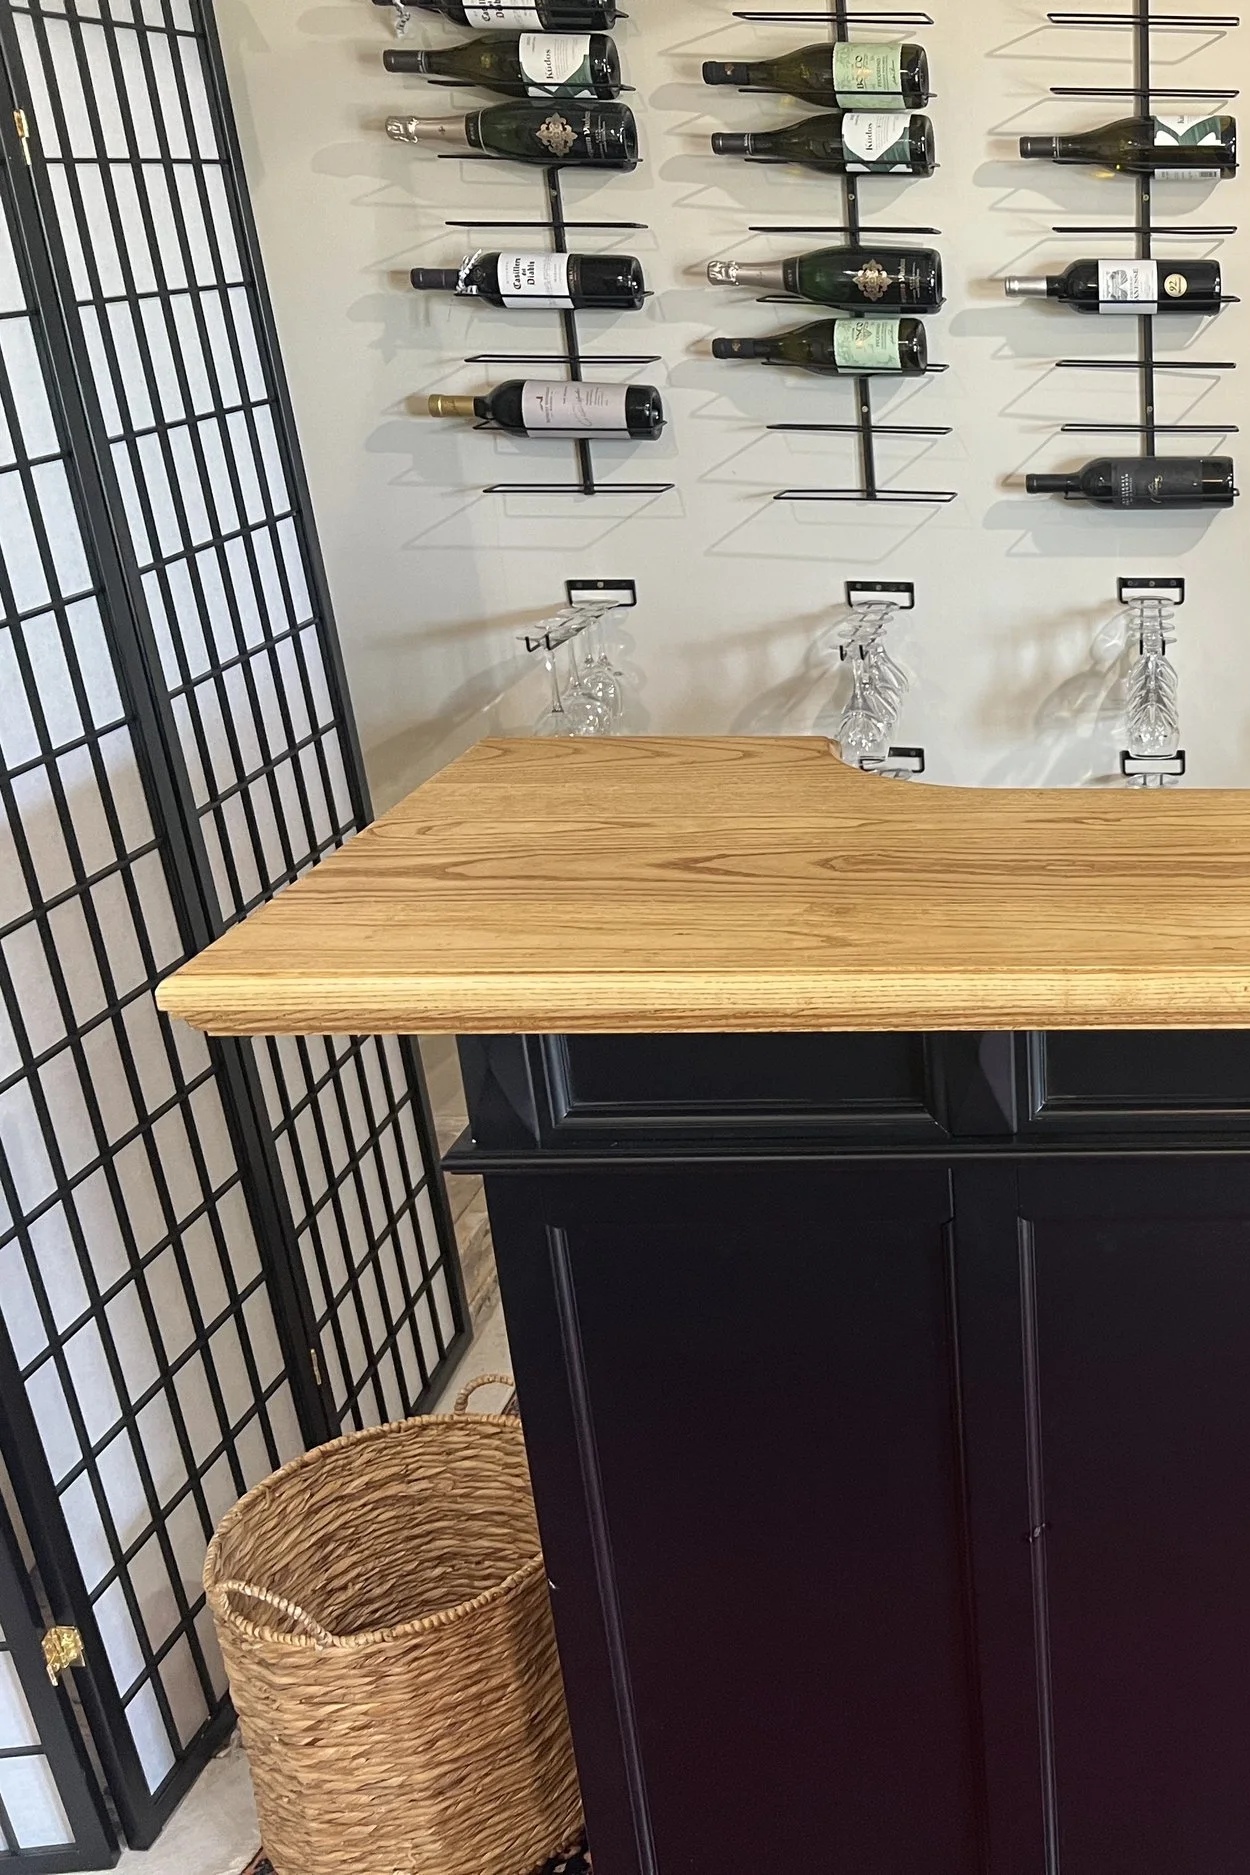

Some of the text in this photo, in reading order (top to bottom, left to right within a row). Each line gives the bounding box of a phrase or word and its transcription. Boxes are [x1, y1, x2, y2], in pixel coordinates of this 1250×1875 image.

[545, 49, 554, 79] Kudos
[854, 55, 865, 89] BOCO
[865, 122, 873, 151] Kudos
[1168, 280, 1178, 292] 92
